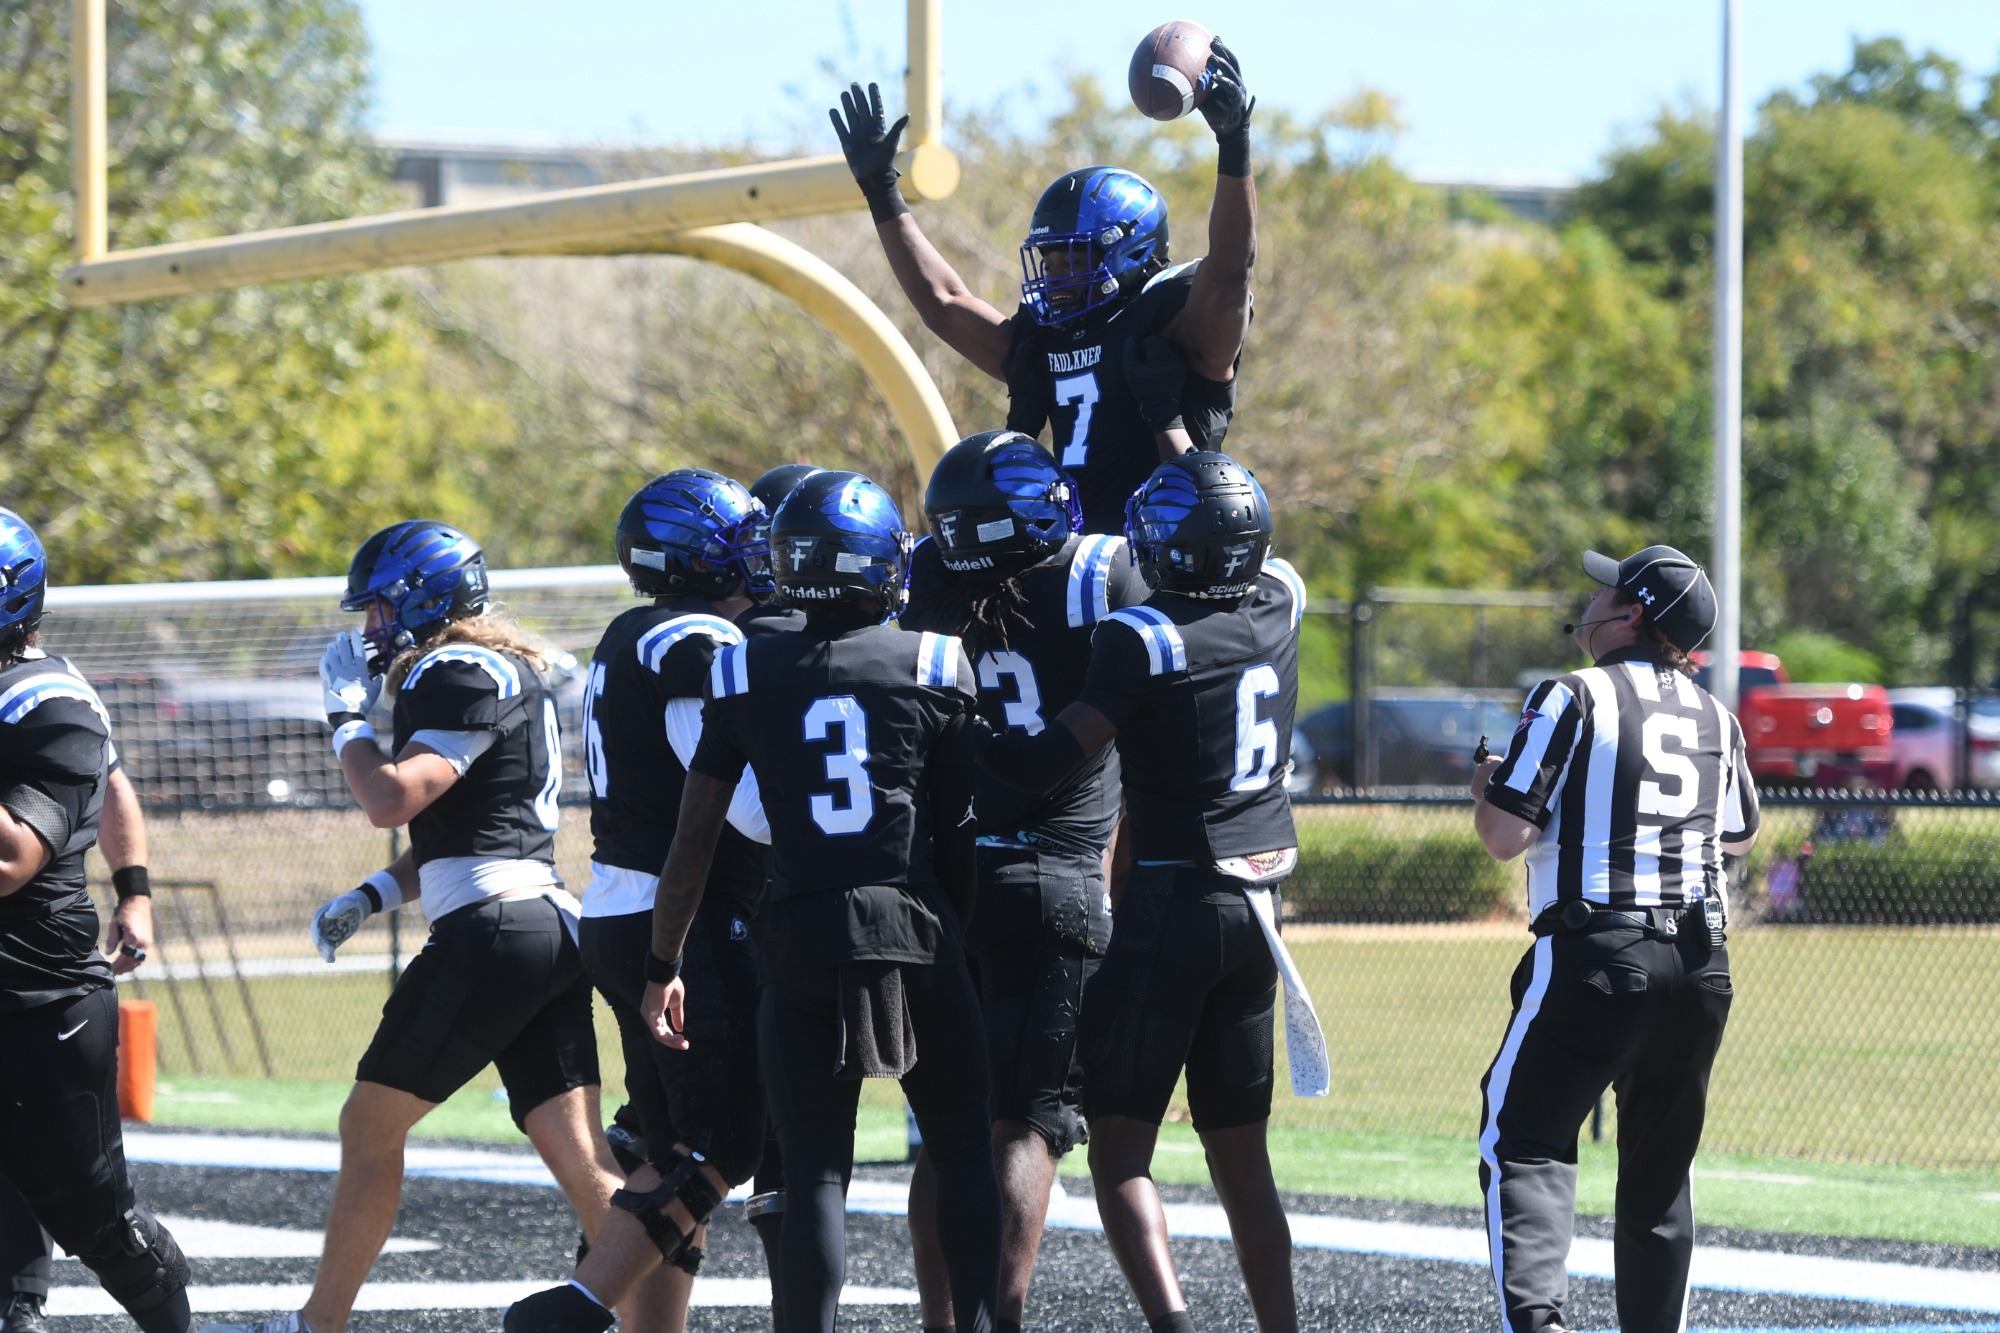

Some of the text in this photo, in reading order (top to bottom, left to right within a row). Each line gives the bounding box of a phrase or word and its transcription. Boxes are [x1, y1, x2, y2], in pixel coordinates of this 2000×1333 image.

[1047, 345, 1102, 373] FAULKNER
[1055, 369, 1101, 467] 7
[943, 556, 995, 572] Riddell
[802, 695, 876, 838] 3
[1229, 662, 1280, 792] 6
[1638, 712, 1700, 818] S
